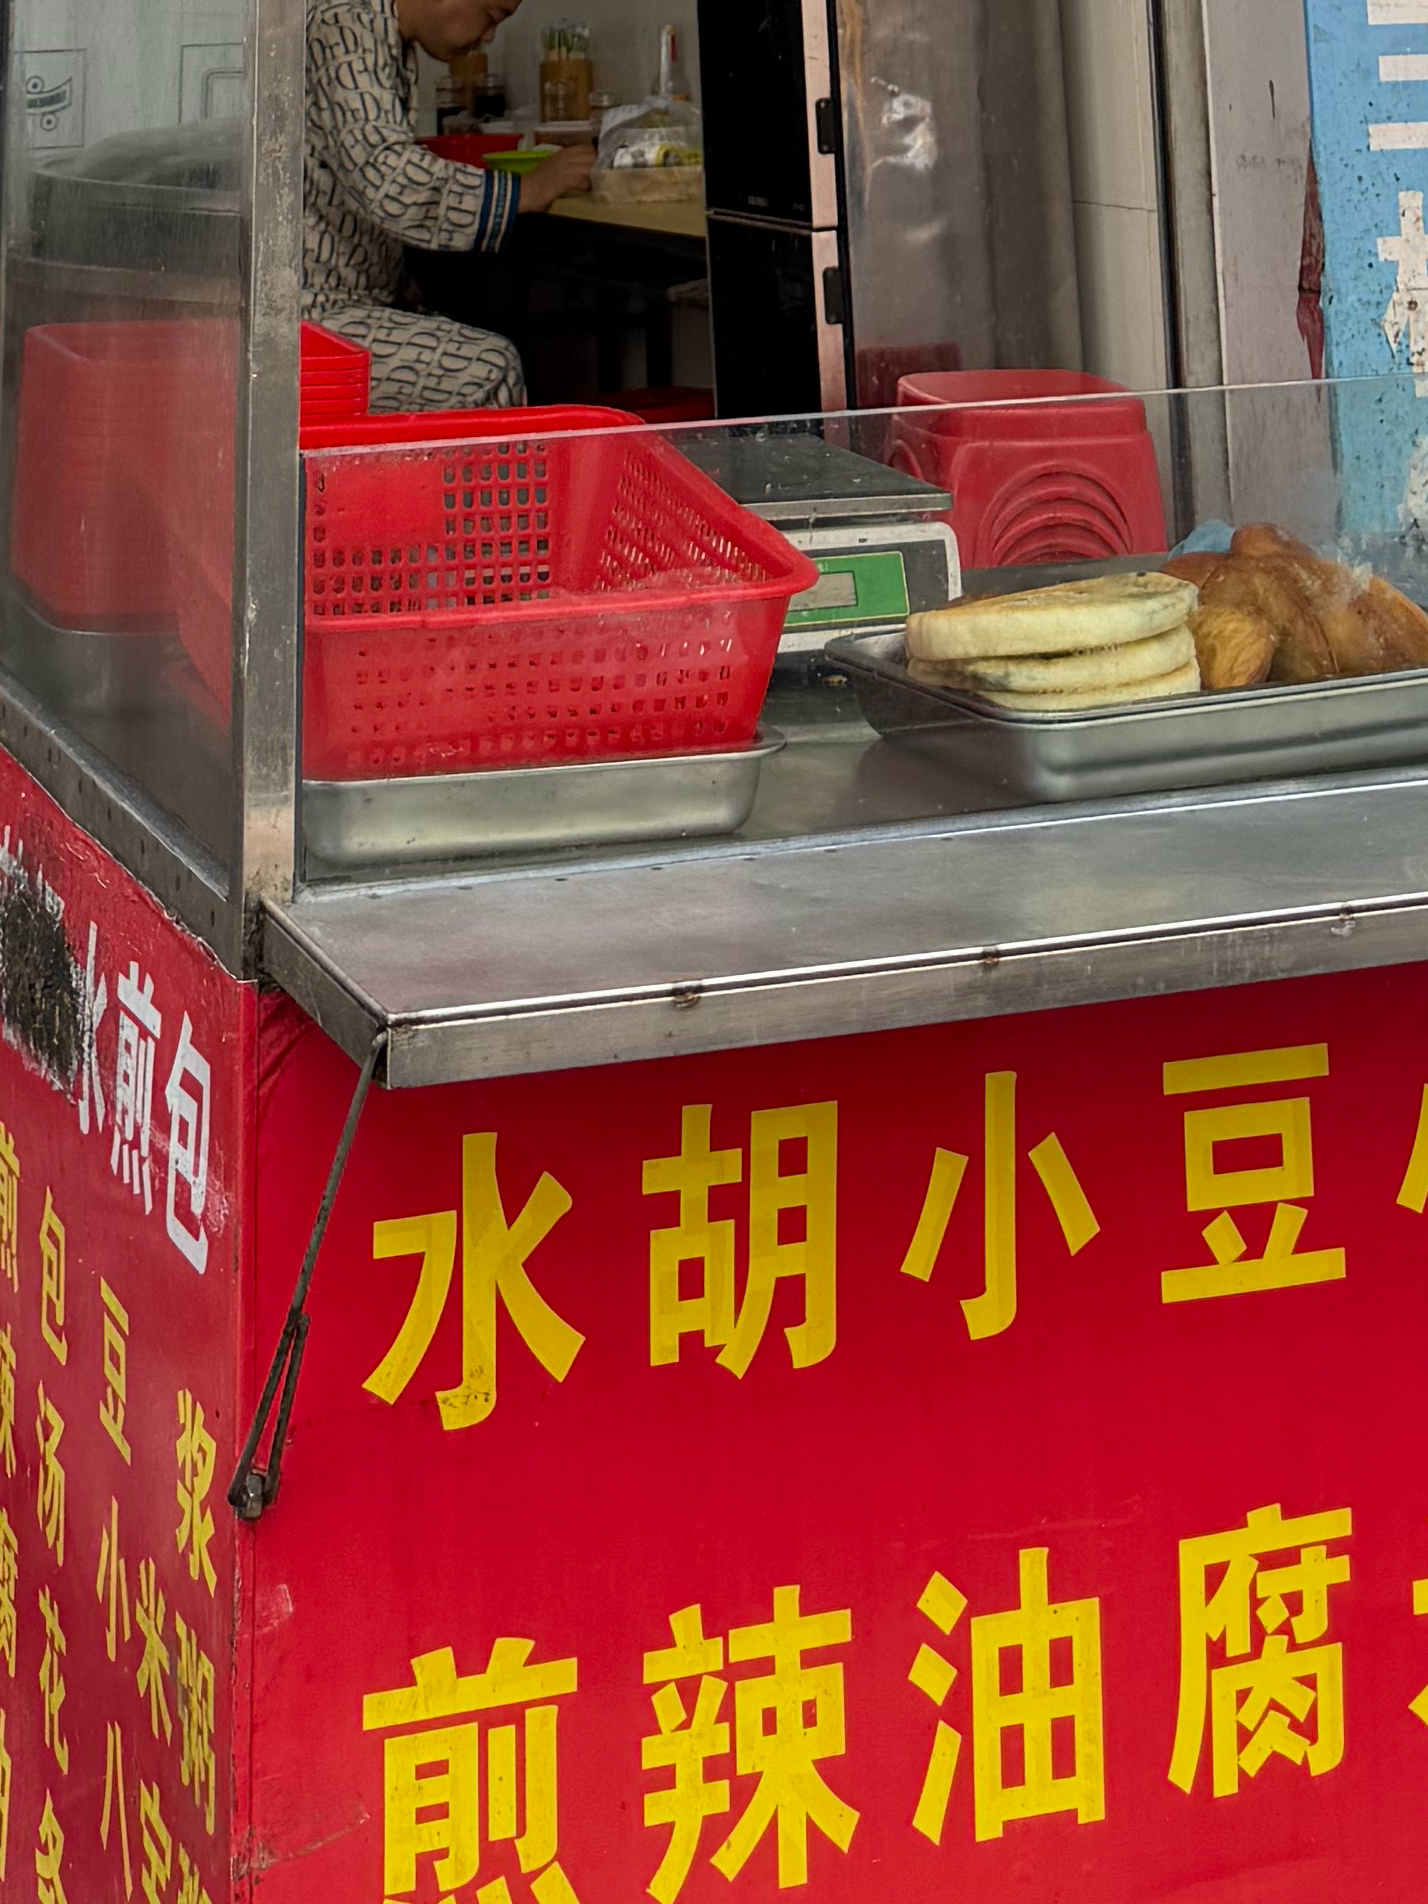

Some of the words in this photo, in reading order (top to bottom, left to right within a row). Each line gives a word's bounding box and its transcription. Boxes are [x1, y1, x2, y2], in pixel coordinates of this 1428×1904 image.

[96, 1496, 215, 1836] 小米粥
[361, 1131, 585, 1904] 水煎
[640, 1100, 860, 1904] 胡辣
[900, 1070, 1105, 1845] 小油
[1160, 1042, 1353, 1797] 豆腐
